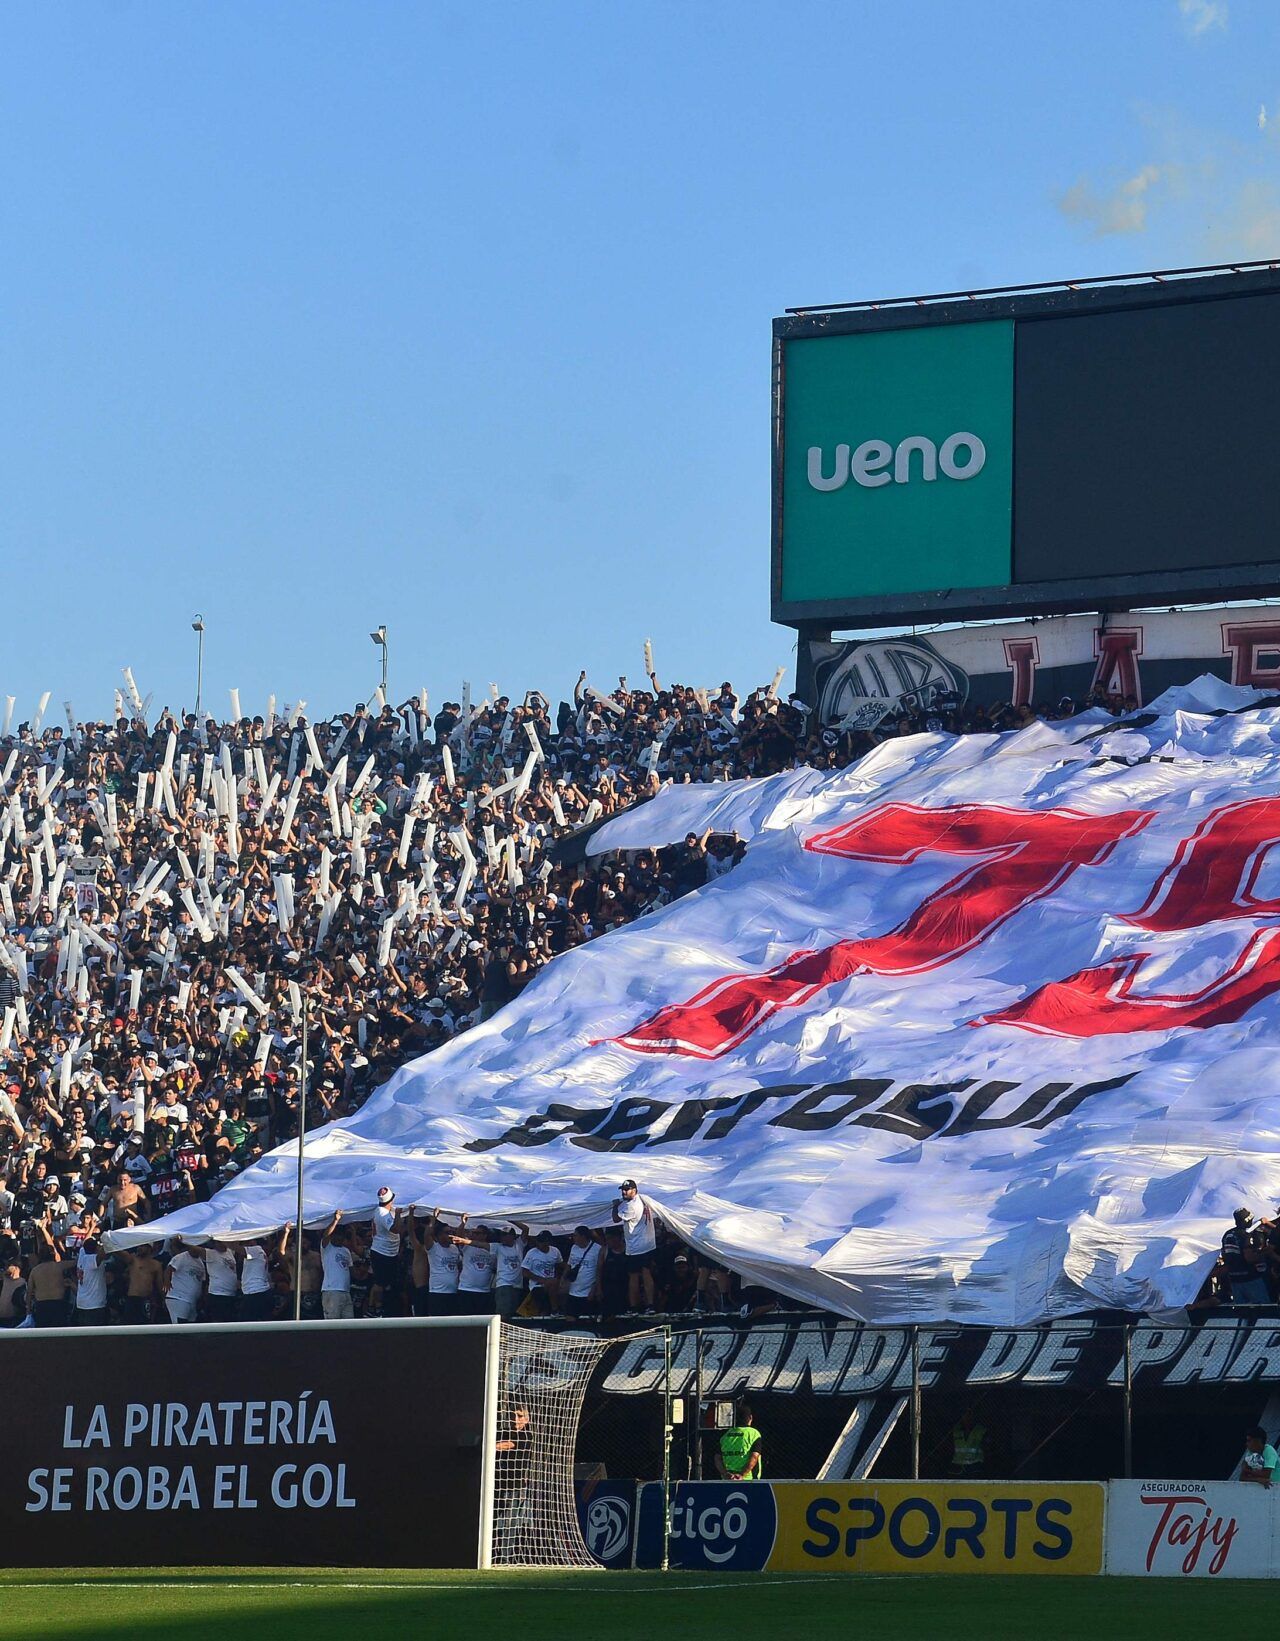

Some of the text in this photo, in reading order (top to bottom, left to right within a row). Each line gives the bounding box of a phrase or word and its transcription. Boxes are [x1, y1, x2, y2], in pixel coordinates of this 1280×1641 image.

[807, 431, 986, 491] ueno
[602, 1322, 960, 1395] GRANDE
[966, 1320, 1096, 1386] DE
[63, 1391, 337, 1449] LA PIRATERÍA
[25, 1463, 356, 1512] SE ROBA EL GOL
[1140, 1482, 1207, 1493] ASEGURADORA
[802, 1497, 1073, 1560] SPORTS
[1140, 1495, 1239, 1575] Tajy
